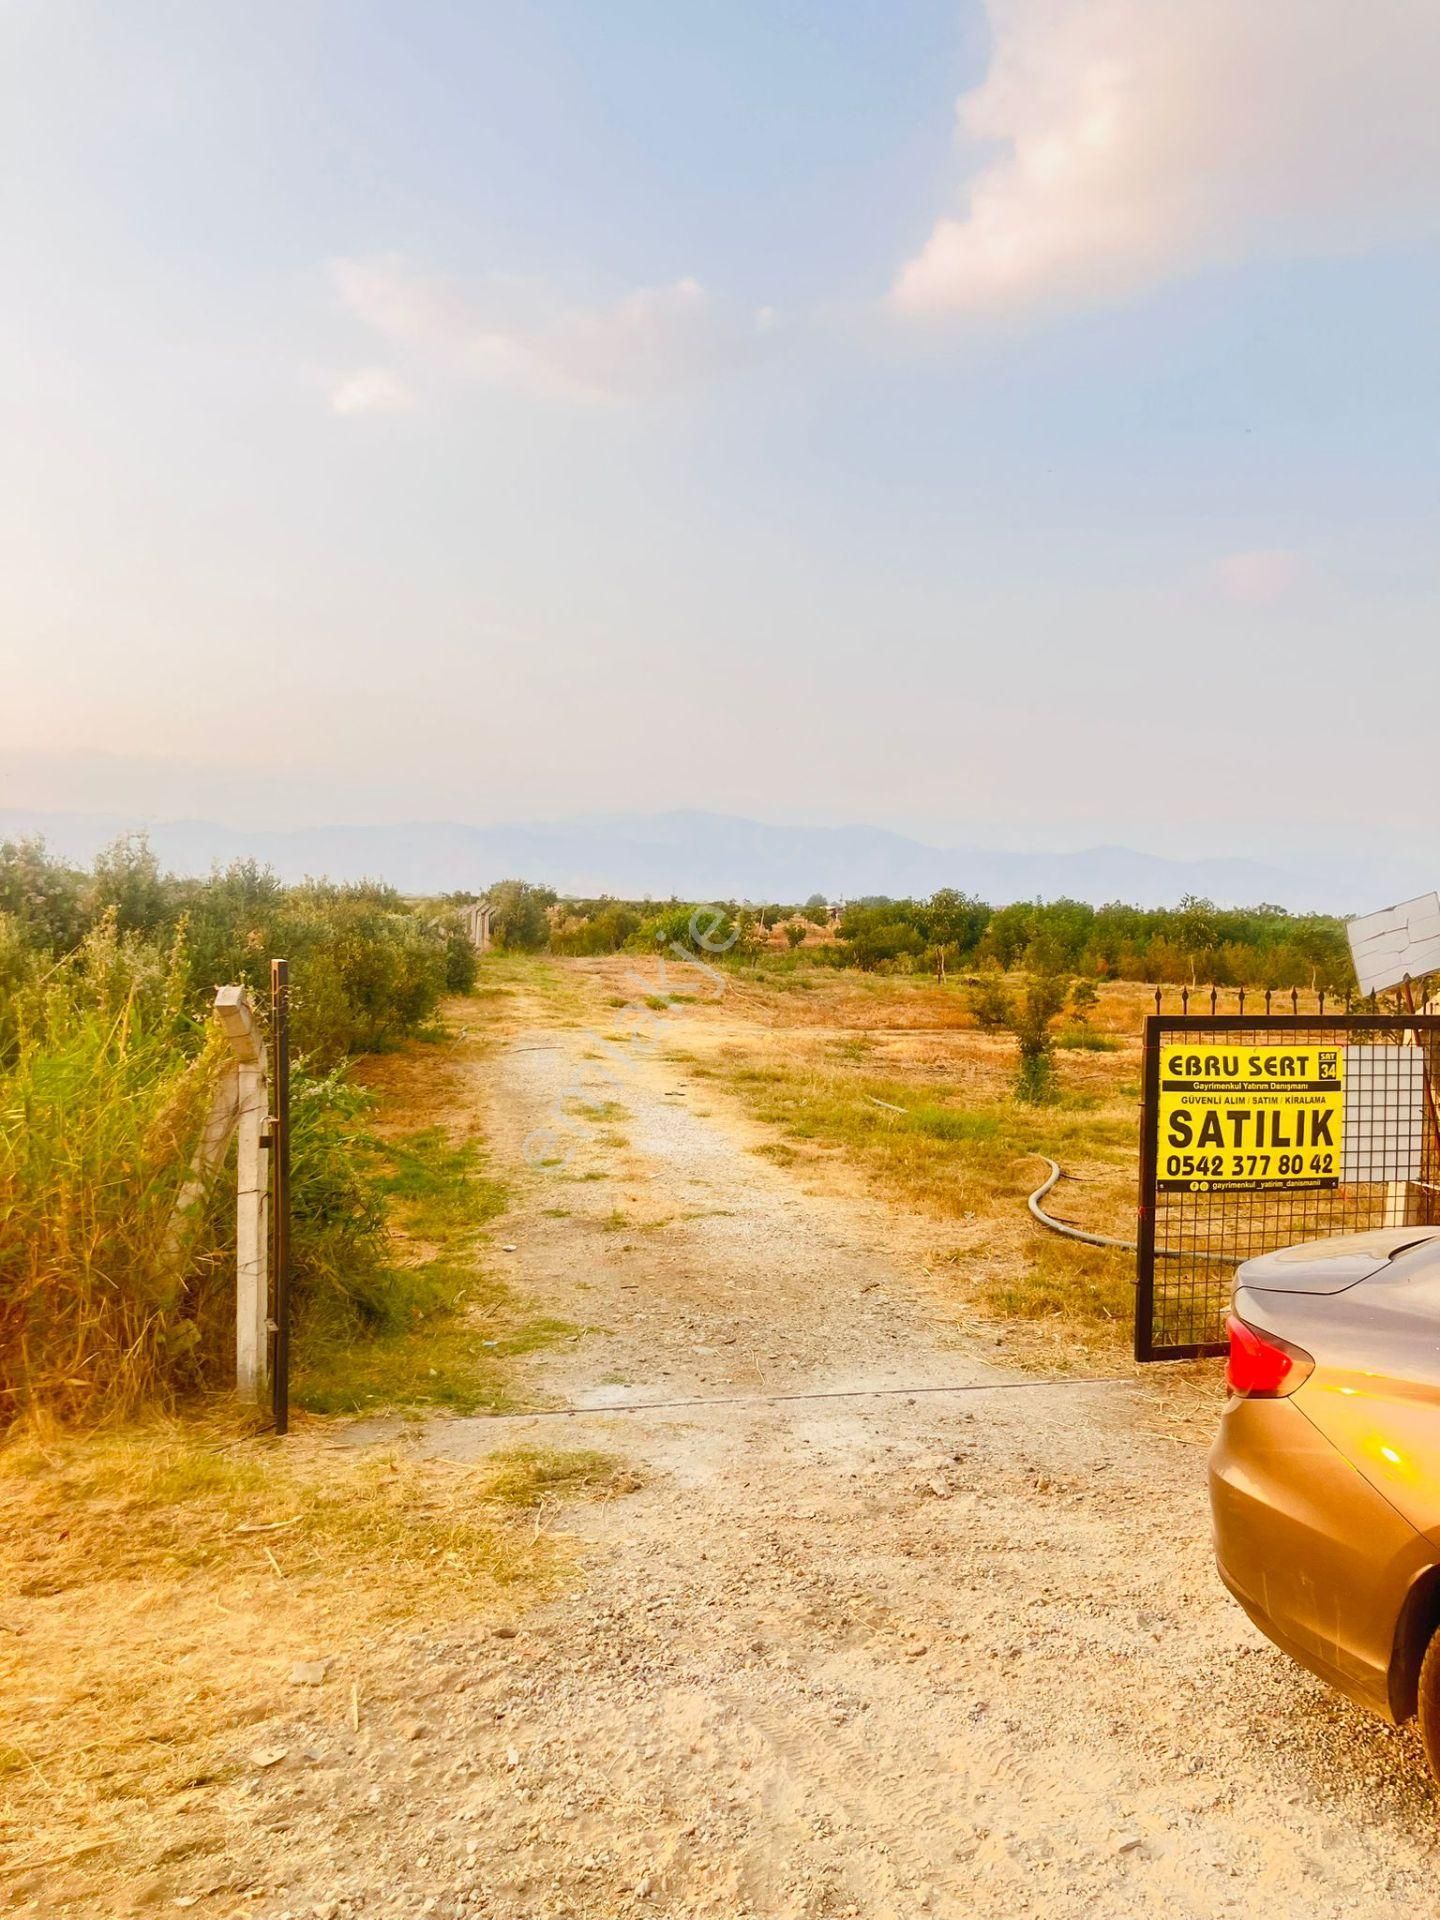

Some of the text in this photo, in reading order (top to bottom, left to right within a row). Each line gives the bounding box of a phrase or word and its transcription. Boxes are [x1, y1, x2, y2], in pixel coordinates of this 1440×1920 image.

[1168, 1055, 1309, 1076] EBRU SERT
[1320, 1064, 1337, 1078] 34
[1193, 1082, 1242, 1091] Gayrimenkul
[1181, 1095, 1222, 1104] GÜVENLİ
[1224, 1096, 1246, 1104] ALIM
[1252, 1096, 1278, 1104] SATIM
[1285, 1095, 1326, 1104] KİRALAMA
[1168, 1109, 1334, 1149] SATILIK
[1166, 1153, 1333, 1176] 0542 377 80 42
